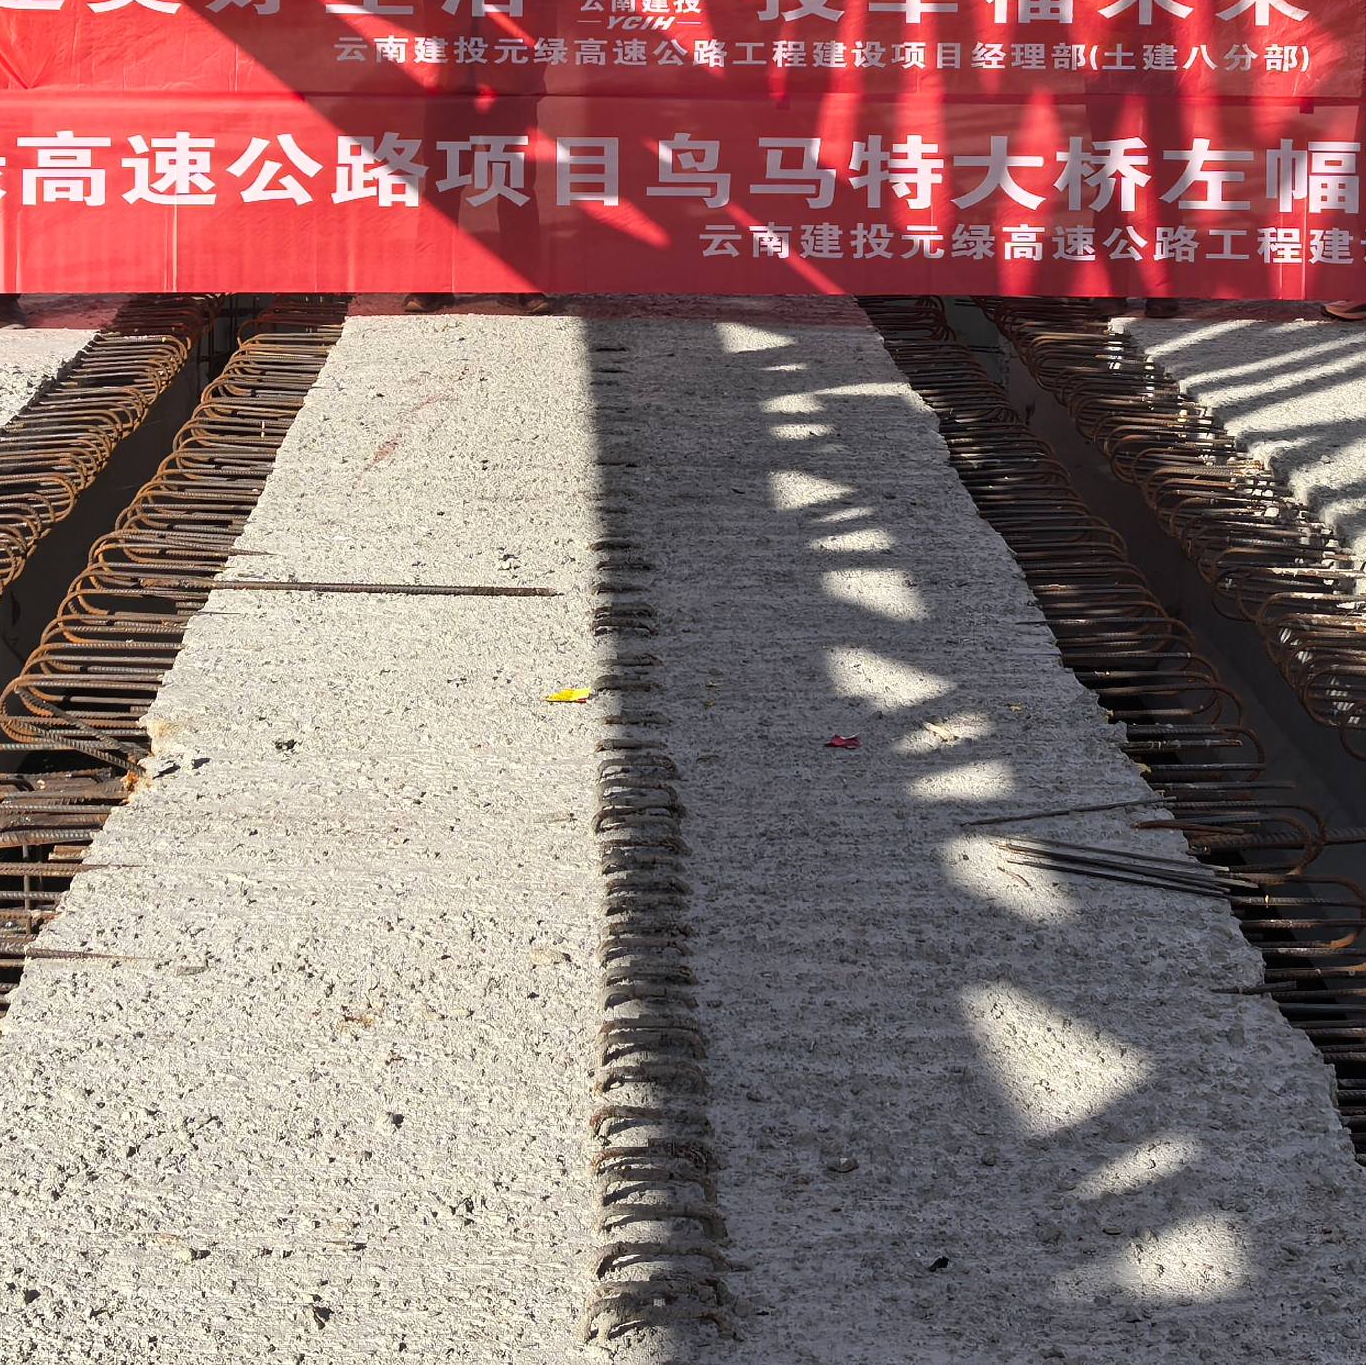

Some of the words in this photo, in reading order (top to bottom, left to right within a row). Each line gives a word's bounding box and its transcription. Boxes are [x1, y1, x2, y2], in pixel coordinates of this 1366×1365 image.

[607, 16, 676, 31] YCIH
[334, 34, 1311, 74] 云南建投元绿高速公路工程建设项目经理部(土建八分部)
